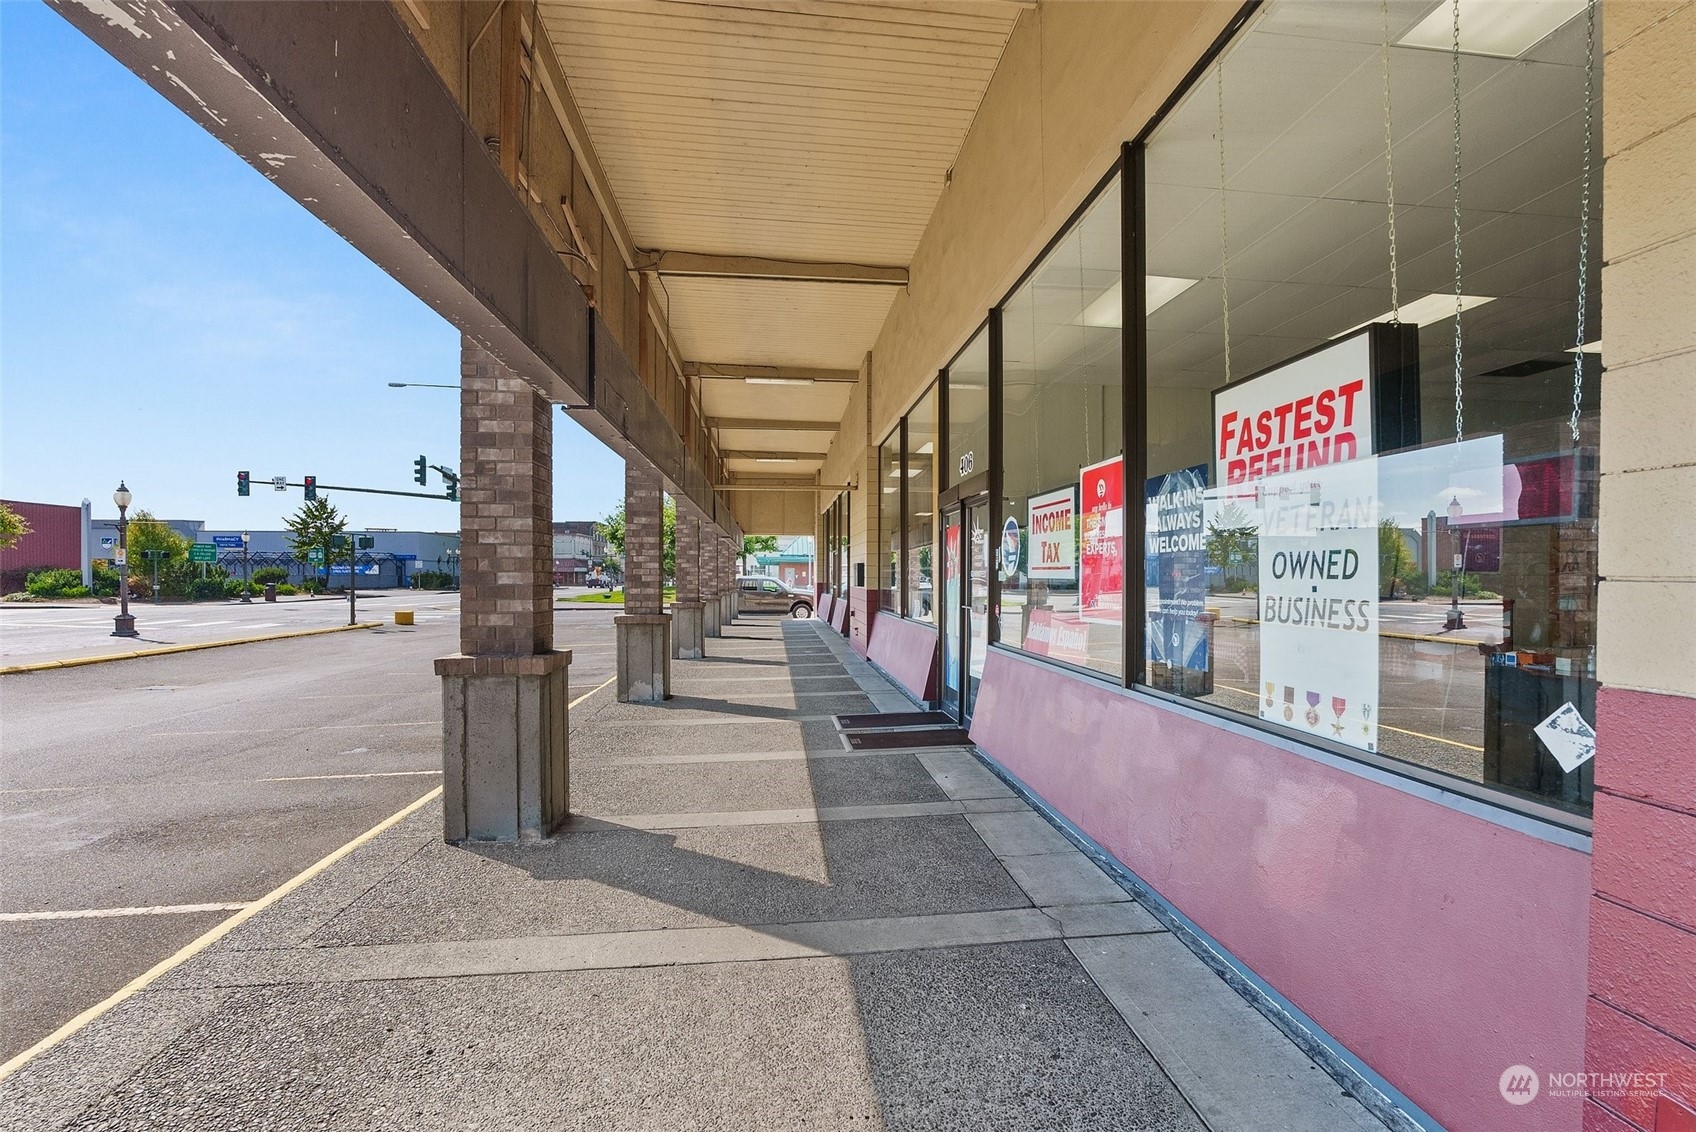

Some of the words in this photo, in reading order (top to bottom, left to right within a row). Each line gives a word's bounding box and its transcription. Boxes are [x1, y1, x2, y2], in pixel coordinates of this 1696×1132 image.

[1220, 379, 1363, 460] FASTEST
[1148, 487, 1204, 512] WALK-INS
[1032, 508, 1071, 535] INCOME
[1263, 495, 1374, 536] VETERAN
[1041, 541, 1060, 563] TAX
[1149, 532, 1206, 554] WELCOME
[1272, 549, 1359, 580] OWNED
[1264, 595, 1370, 632] BUSINESS
